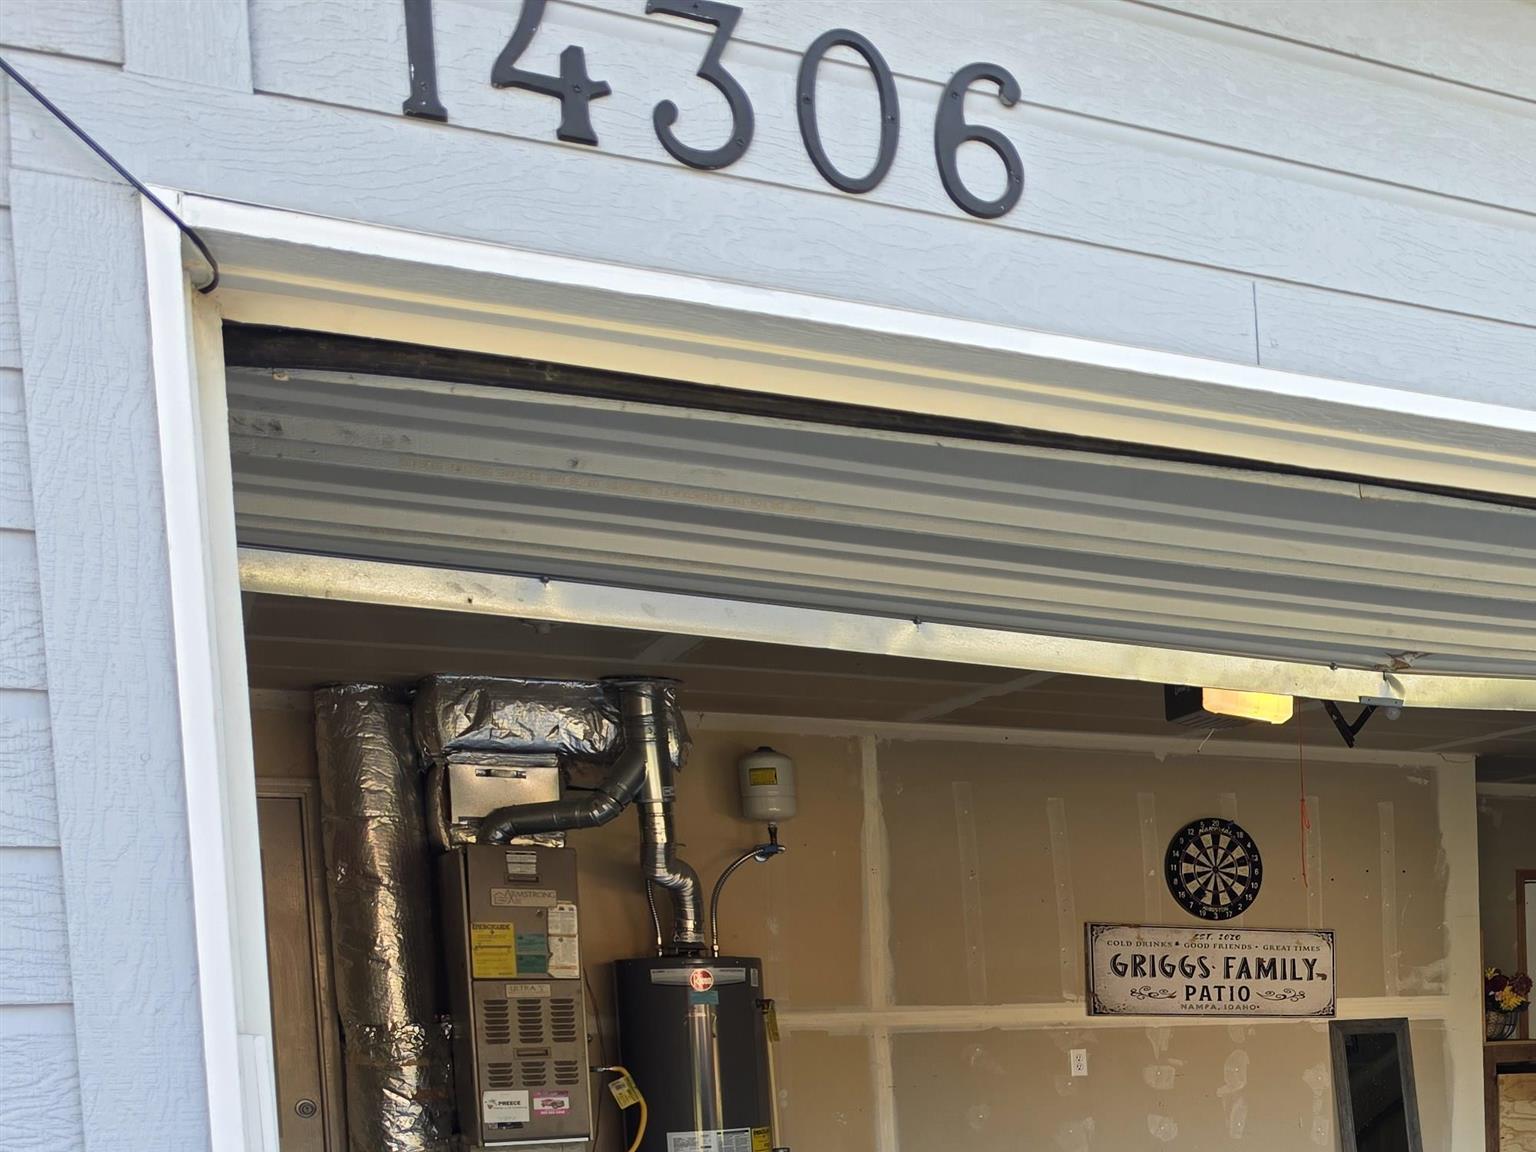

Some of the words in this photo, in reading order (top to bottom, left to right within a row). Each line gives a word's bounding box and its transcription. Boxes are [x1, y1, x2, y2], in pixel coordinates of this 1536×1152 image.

[403, 0, 1025, 219] 14306
[1189, 901, 1194, 909] 7
[1238, 903, 1243, 911] 2
[1193, 933, 1214, 941] EST.
[1218, 933, 1241, 941] 2020
[1136, 940, 1173, 948] DRINKS
[1109, 953, 1211, 979] GRIGGS
[1223, 956, 1318, 981] FAMILY
[1185, 984, 1251, 1002] PATIO
[1223, 1003, 1257, 1011] IDAHO
